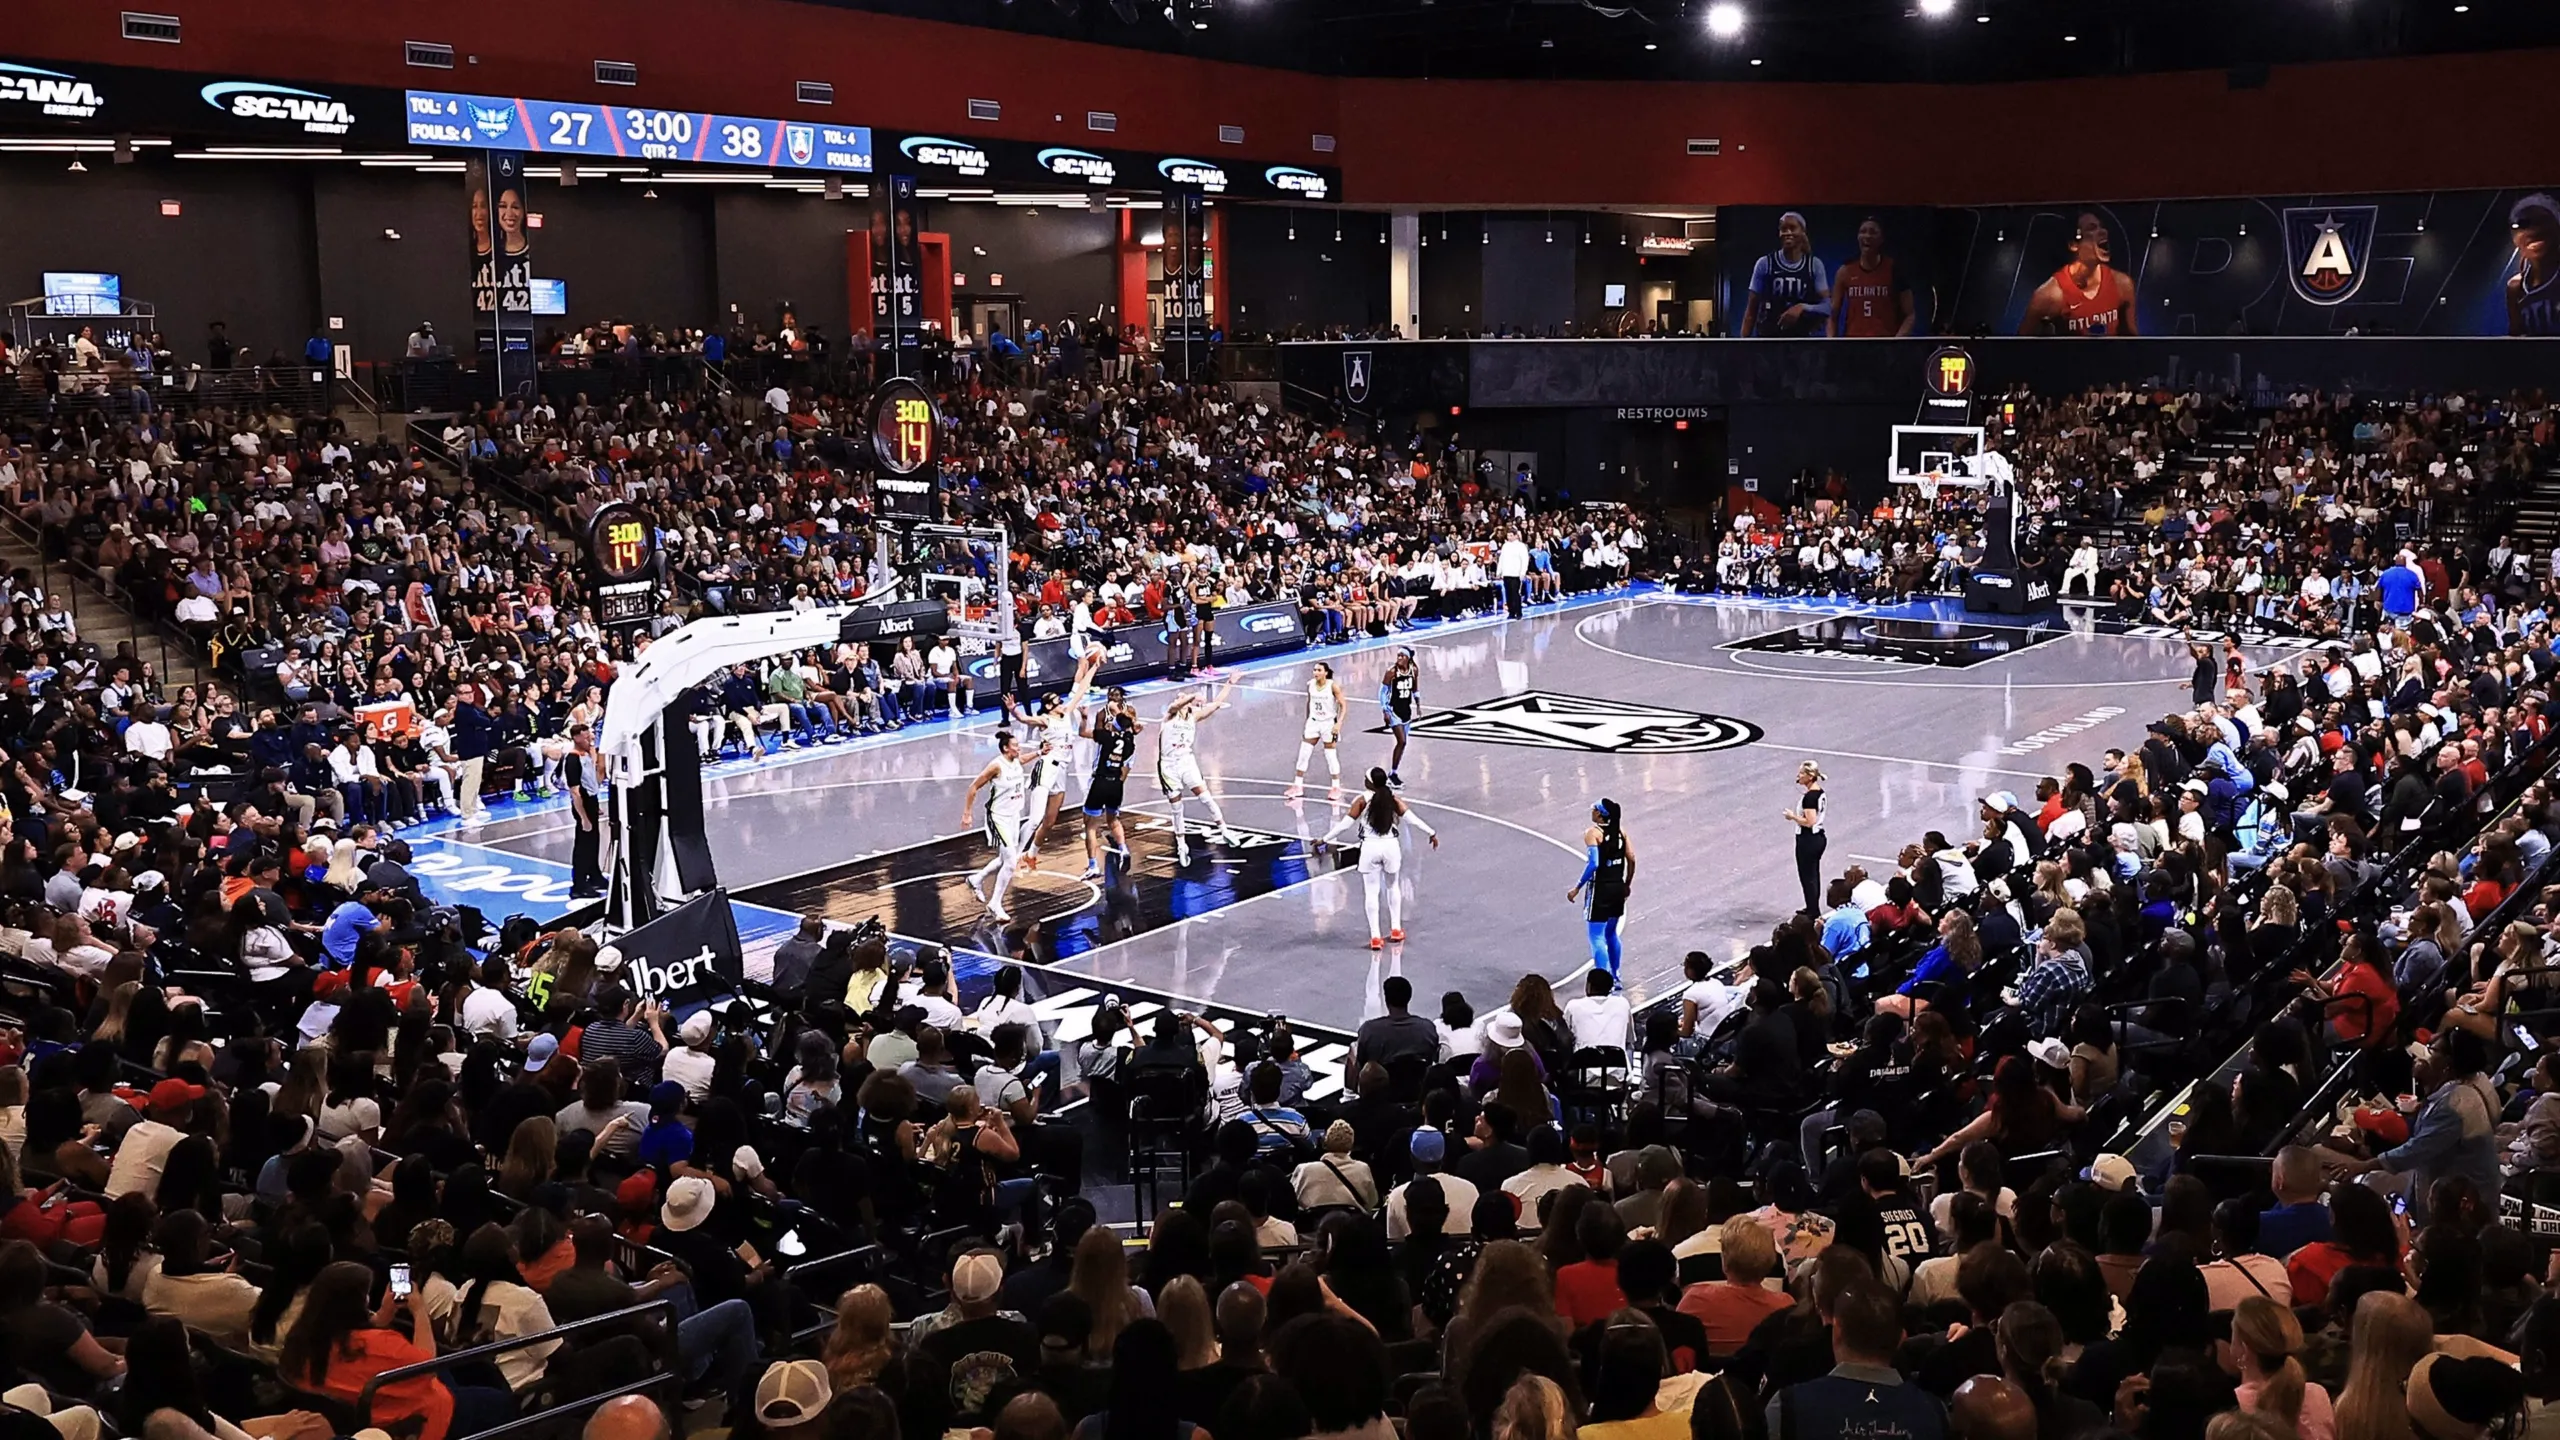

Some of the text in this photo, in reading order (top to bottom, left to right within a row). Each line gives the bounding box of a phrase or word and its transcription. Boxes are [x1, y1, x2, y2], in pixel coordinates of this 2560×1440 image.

[0, 76, 96, 105] CANA
[232, 95, 349, 123] SCANA
[409, 97, 458, 115] TOL: 4
[411, 123, 472, 142] FOULS: 4
[549, 111, 593, 146] 27
[626, 109, 692, 144] 3:00
[721, 124, 763, 158] 38
[823, 130, 857, 145] TOL: 4
[641, 143, 678, 159] QTR 2
[827, 152, 872, 168] FOULS: 2
[917, 147, 986, 167] SCANA
[1052, 157, 1112, 176] SCANA
[1171, 167, 1225, 184] SCANA
[1277, 175, 1324, 191] SCANA
[502, 290, 530, 312] 42
[877, 295, 887, 316] 5
[902, 295, 913, 316] 5
[1164, 301, 1183, 318] 10
[1863, 301, 1872, 317] 5
[2068, 309, 2119, 332] ATLANTA
[1942, 371, 1964, 391] 14
[895, 399, 929, 423] 3:00
[1617, 407, 1708, 419] RESTROOMS
[901, 423, 927, 462] 14
[608, 522, 642, 544] 3:00
[614, 543, 637, 570] 14
[2027, 580, 2051, 602] Albert
[878, 617, 915, 635] Albert
[1251, 615, 1293, 633] SCANA
[379, 711, 398, 732] G
[1113, 739, 1125, 755] 2
[1880, 1208, 1917, 1223] SIEGRIST
[1884, 1221, 1930, 1256] 20
